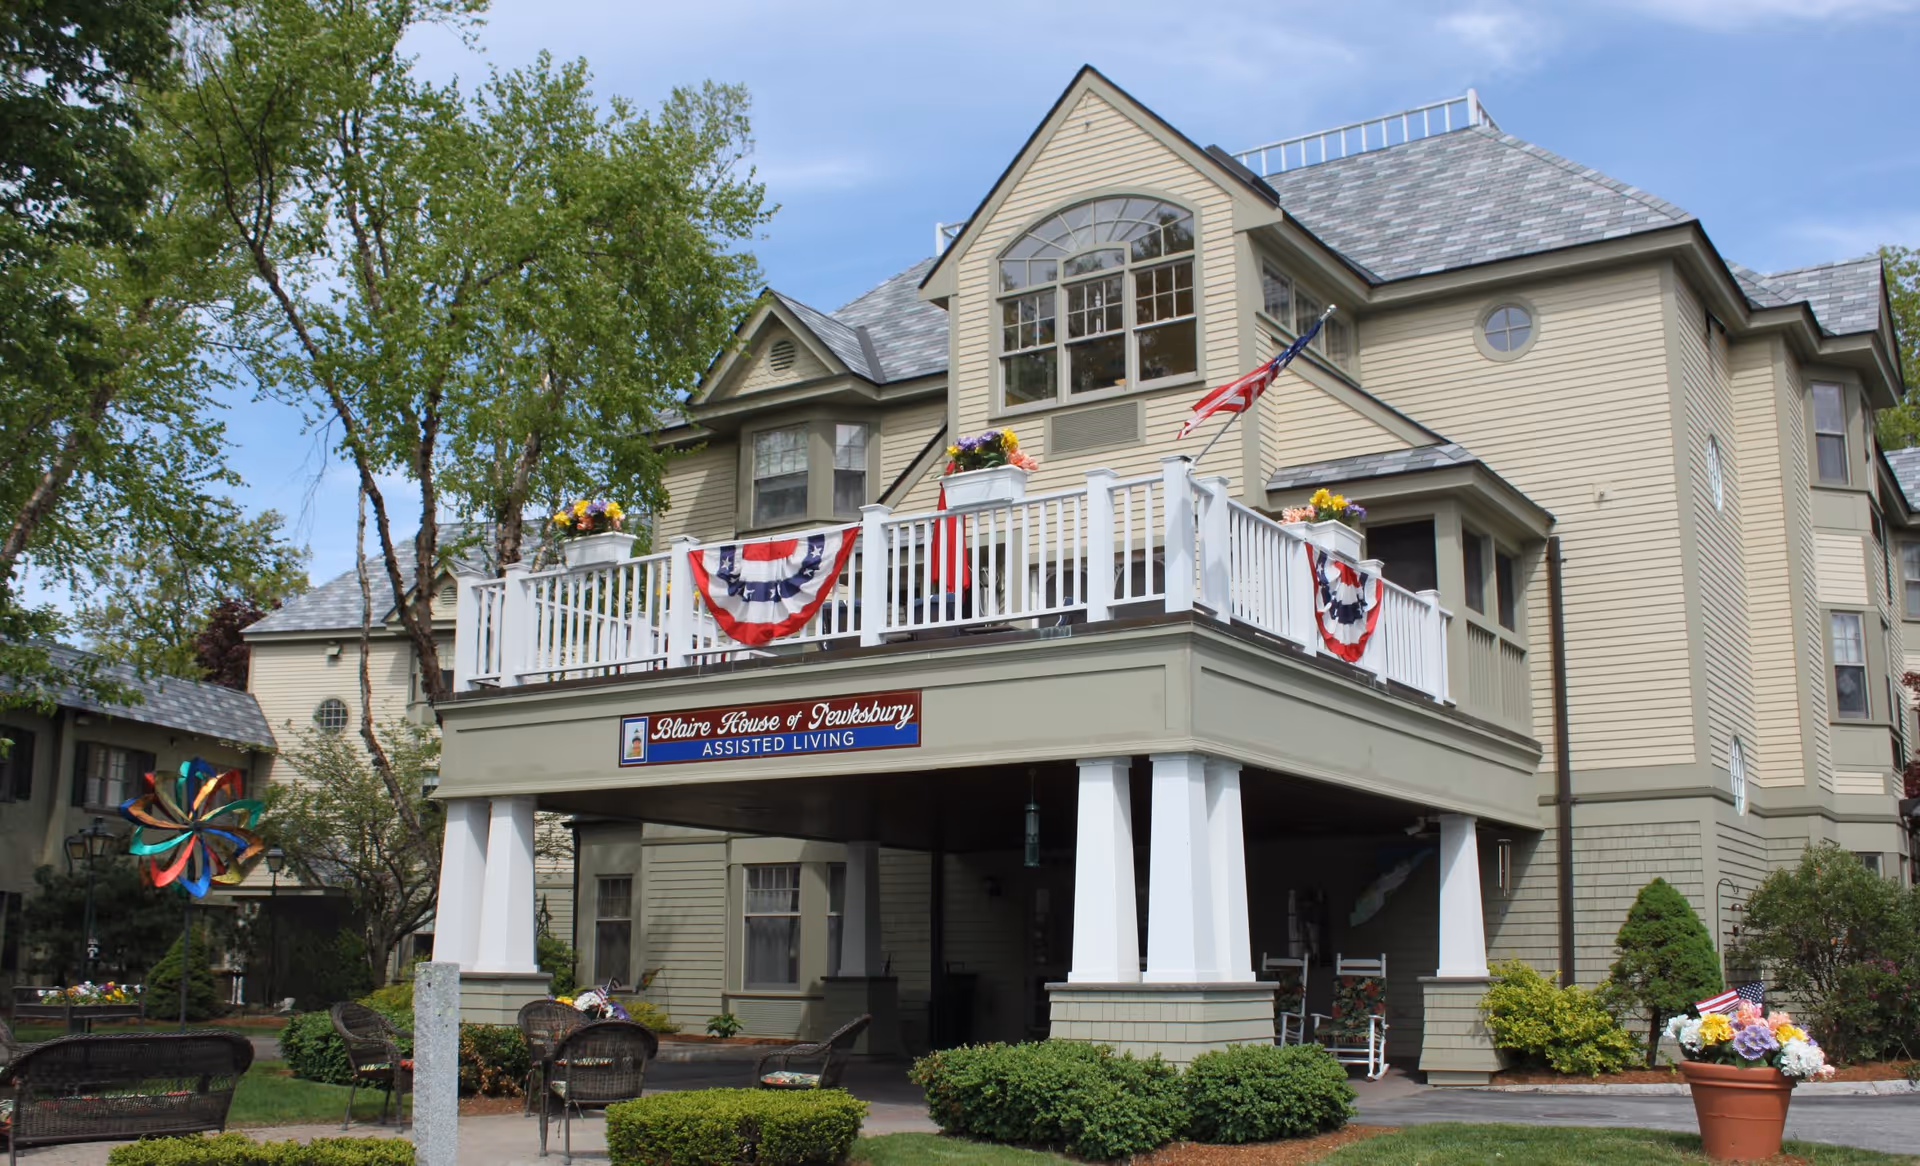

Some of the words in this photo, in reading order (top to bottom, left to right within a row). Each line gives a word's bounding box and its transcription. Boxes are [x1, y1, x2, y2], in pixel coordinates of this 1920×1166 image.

[651, 717, 712, 740] Blaire
[717, 711, 780, 734] House
[787, 711, 802, 730] of
[808, 700, 914, 730] Tewksbury
[702, 737, 785, 756] ASSISTED
[793, 731, 854, 750] LIVING
